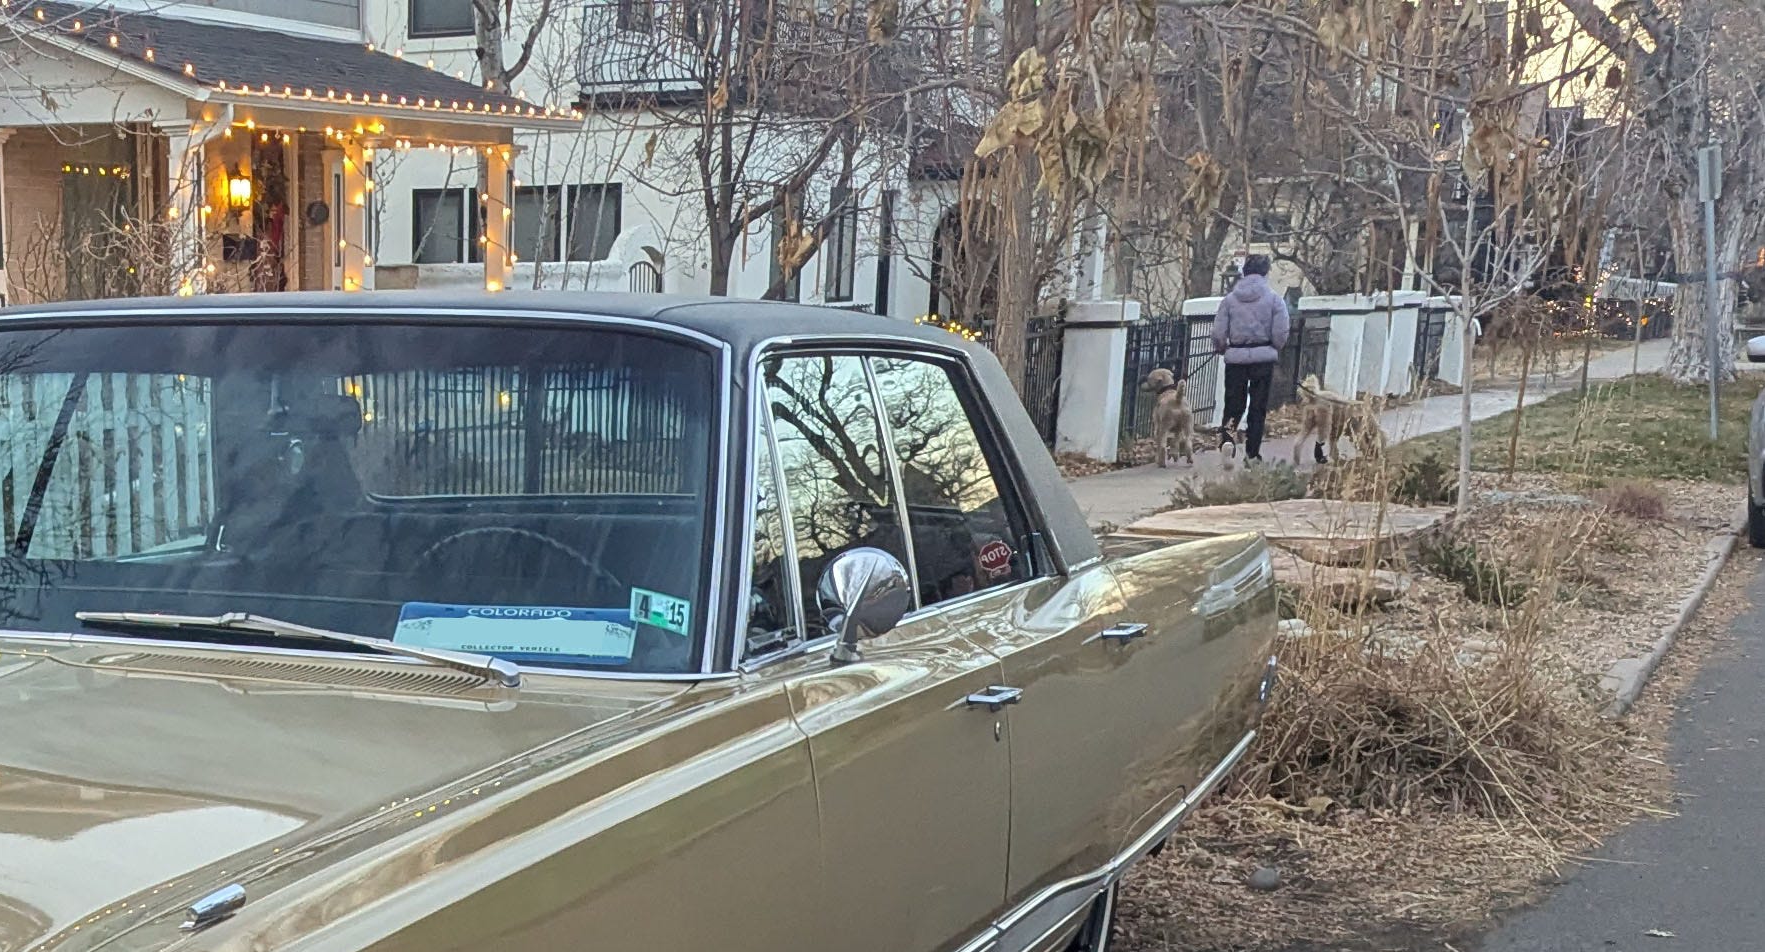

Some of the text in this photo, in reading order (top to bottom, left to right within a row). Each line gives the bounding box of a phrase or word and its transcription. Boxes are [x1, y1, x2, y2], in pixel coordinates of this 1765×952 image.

[467, 607, 572, 617] COLORADO
[639, 595, 649, 619] 4
[668, 601, 685, 626] 15
